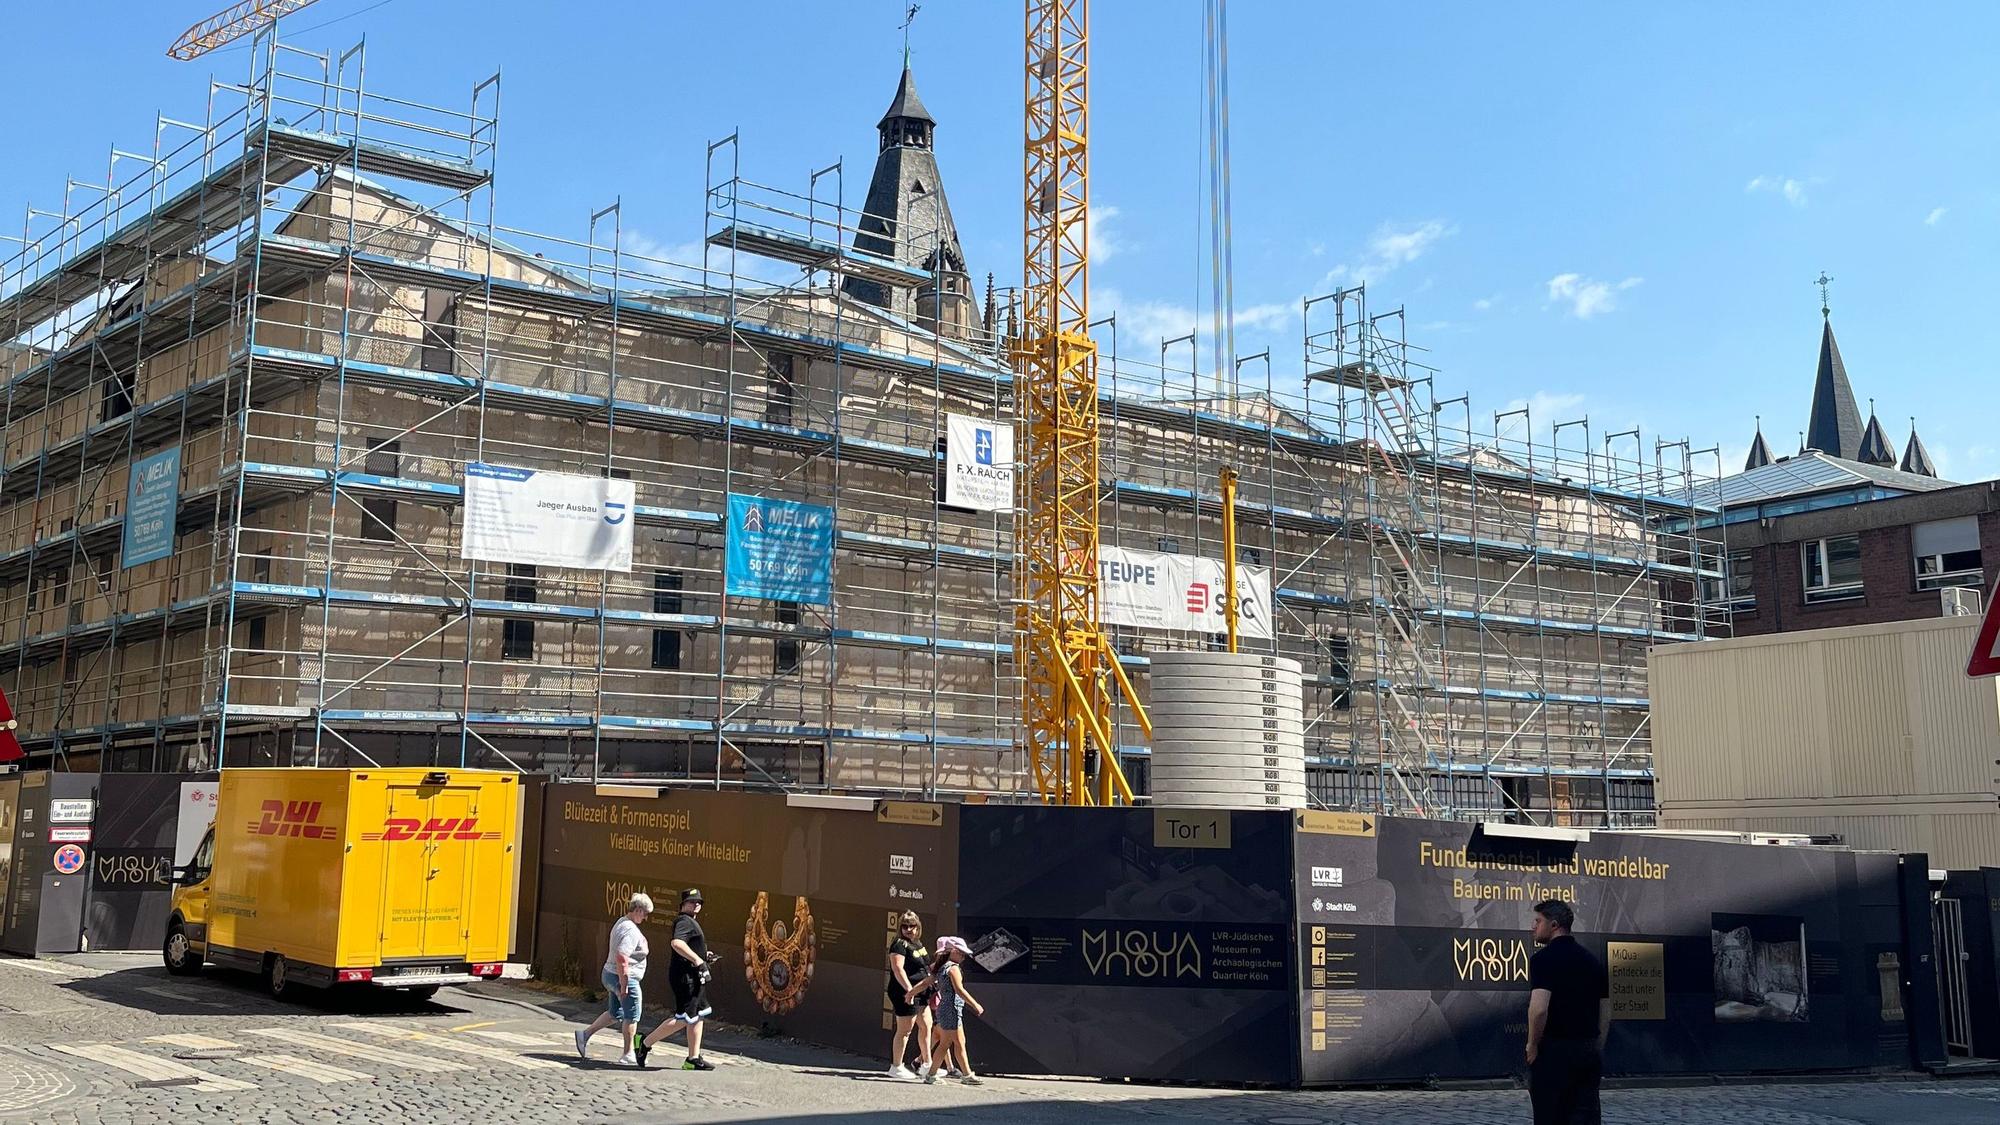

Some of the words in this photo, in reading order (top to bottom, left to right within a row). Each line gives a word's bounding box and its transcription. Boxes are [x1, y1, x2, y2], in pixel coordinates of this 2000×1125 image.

[978, 467, 1010, 481] RAUCH
[537, 500, 564, 511] Jaeger
[566, 503, 597, 512] Ausbau
[768, 507, 820, 529] MELIK
[749, 559, 780, 573] 50769
[783, 562, 808, 576] Köln
[1098, 560, 1155, 585] TEUPE
[258, 800, 323, 838] DHL
[564, 801, 608, 824] Blütezeit
[610, 804, 618, 824] &
[621, 806, 691, 834] Formenspiel
[381, 818, 484, 840] DHL
[1166, 819, 1200, 839] Tor
[1209, 821, 1217, 839] 1
[609, 833, 660, 856] Vielfältiges
[661, 837, 694, 857] Kölner
[696, 841, 751, 863] Mittelalter
[891, 858, 904, 868] LVR
[1419, 842, 1542, 872] Fundamental
[1548, 852, 1579, 875] und
[1583, 855, 1670, 880] wandelbar
[1313, 870, 1330, 879] LVR
[899, 889, 912, 898] Stadt
[1453, 878, 1501, 900] Bauen
[1505, 881, 1523, 901] im
[1527, 883, 1576, 904] Viertel
[1326, 902, 1342, 911] Stadt
[1343, 903, 1357, 912] Köln
[1212, 945, 1248, 953] Museum
[1250, 945, 1261, 954] im
[1212, 971, 1247, 980] Quartier
[1250, 972, 1269, 981] Köln
[1612, 965, 1649, 977] Entdecke
[1650, 967, 1663, 977] die
[1612, 983, 1633, 994] Stadt
[1635, 984, 1656, 994] unter
[1613, 1000, 1626, 1011] der
[1629, 1000, 1649, 1012] Stadt
